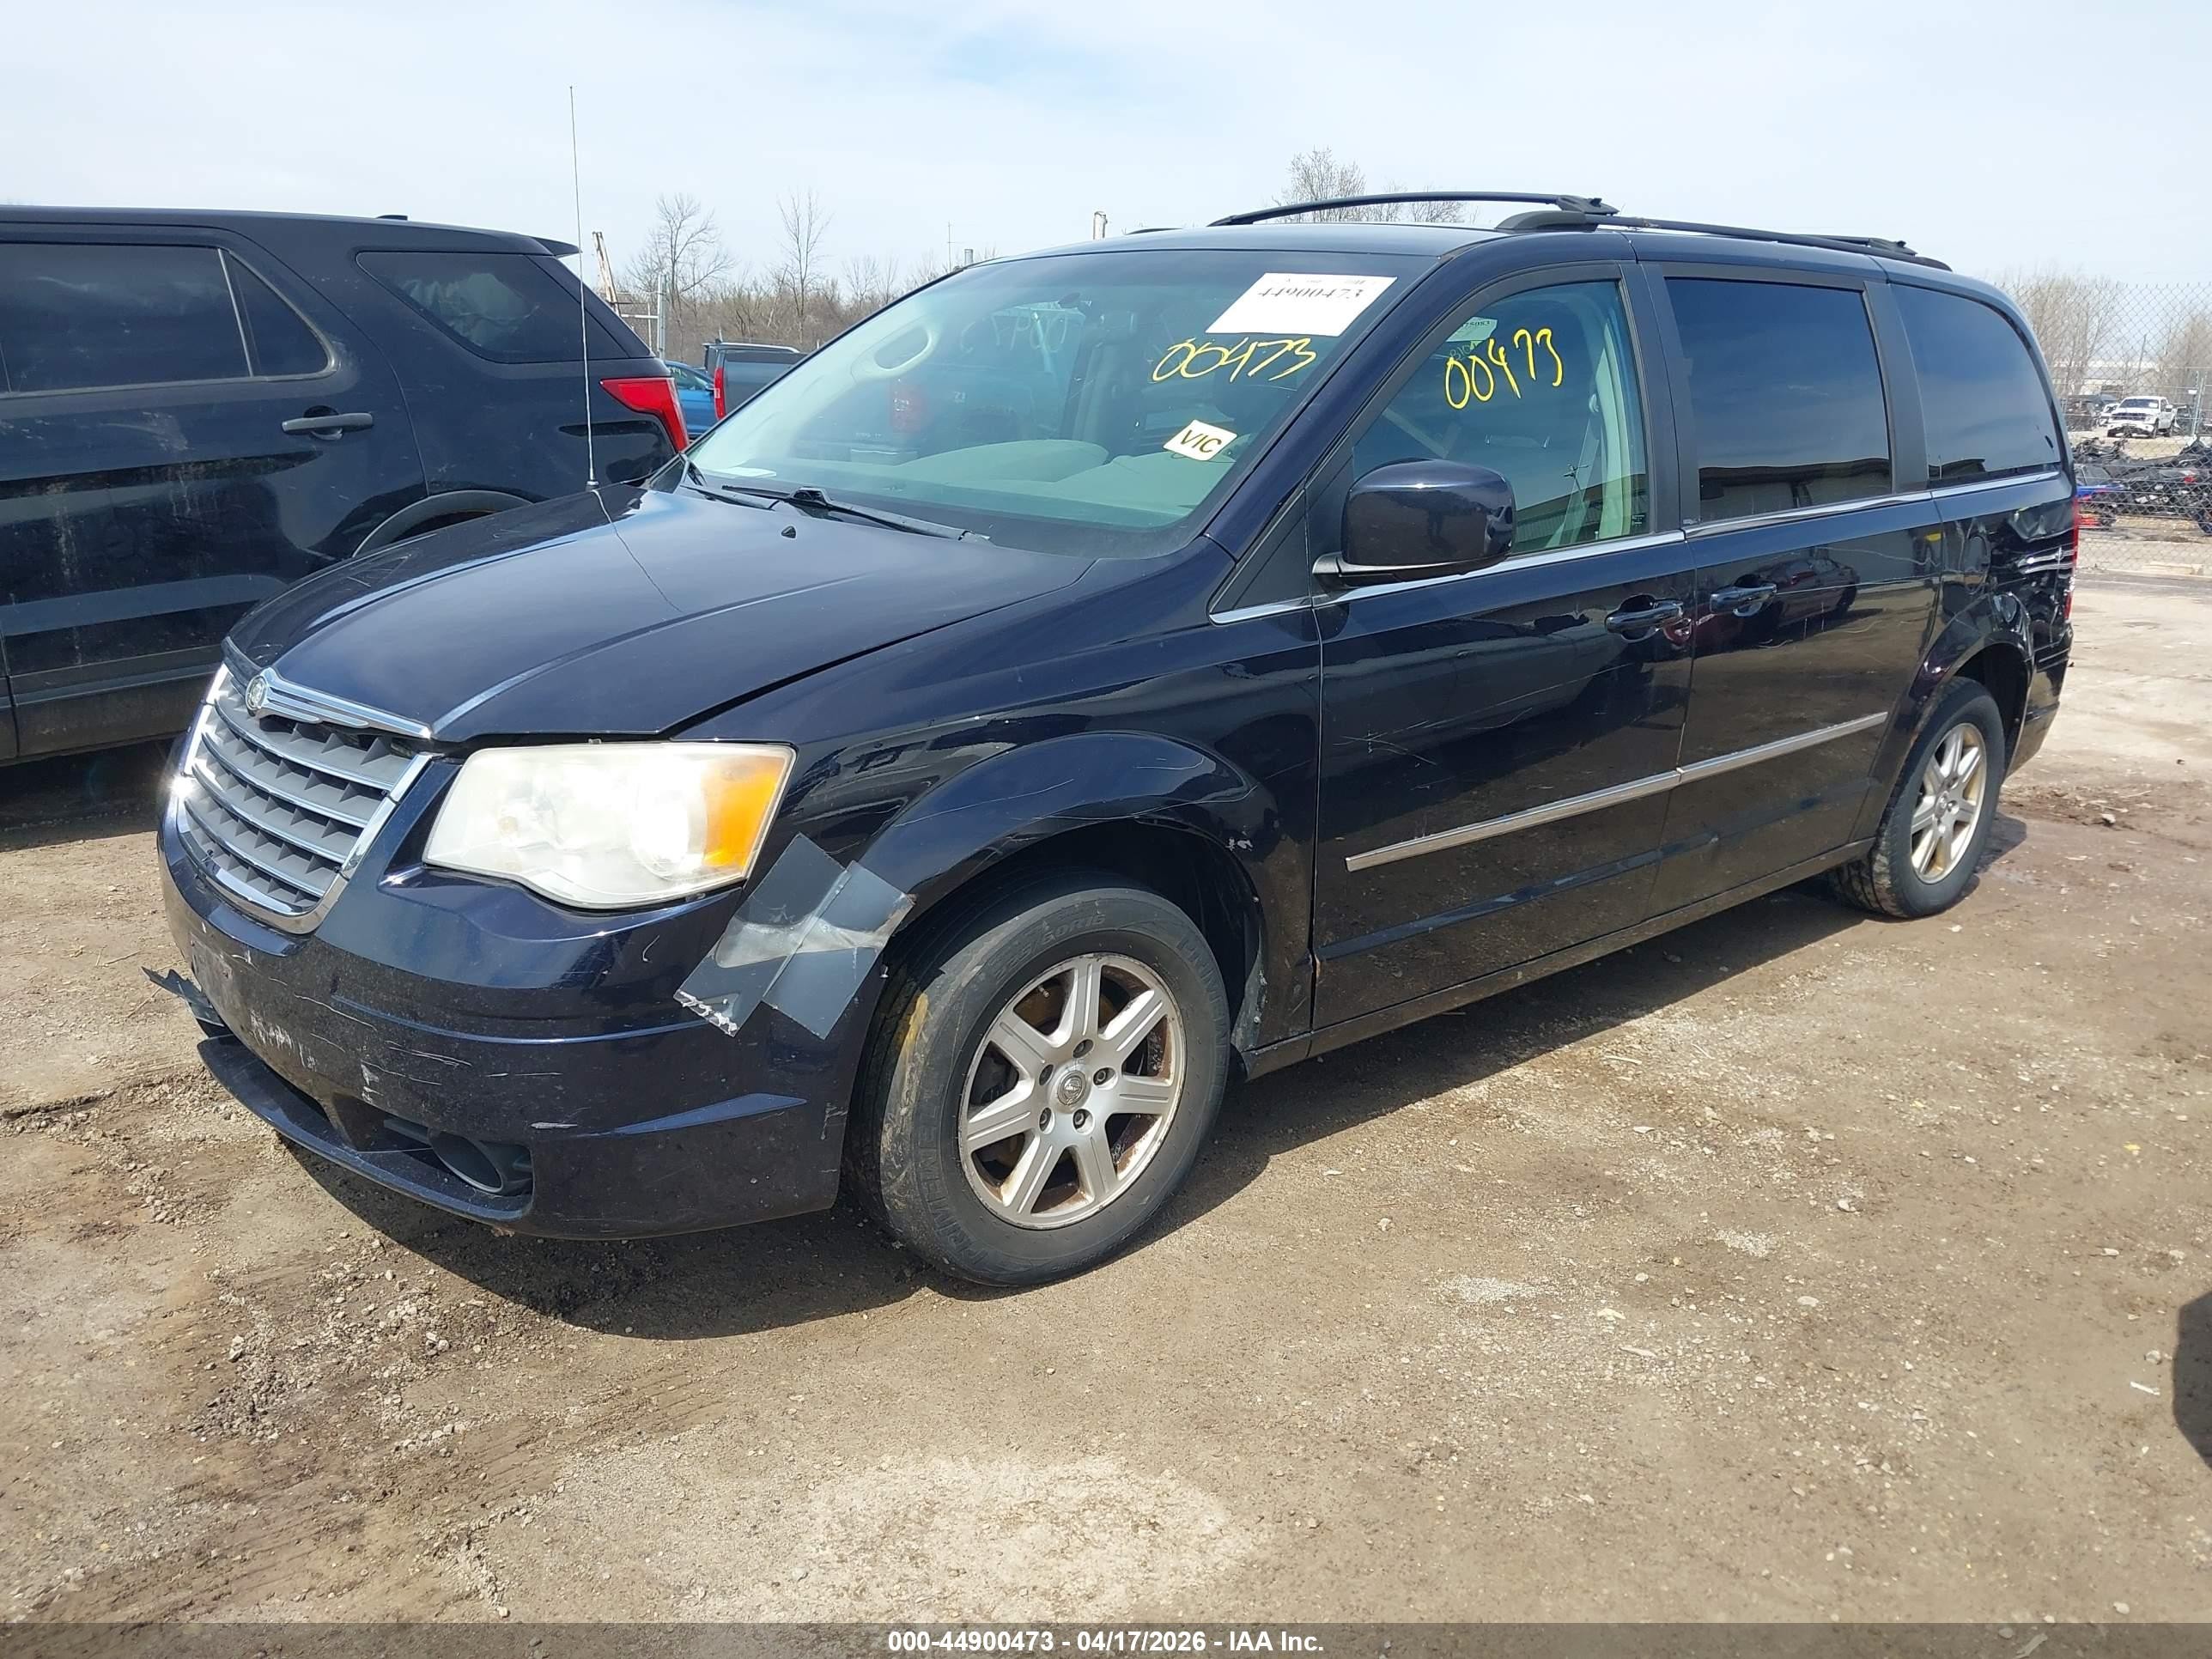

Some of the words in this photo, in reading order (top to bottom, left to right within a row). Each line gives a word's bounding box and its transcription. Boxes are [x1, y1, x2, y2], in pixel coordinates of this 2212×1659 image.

[1152, 336, 1317, 383] 00473
[1445, 328, 1564, 410] 00473
[1180, 429, 1223, 453] VIC
